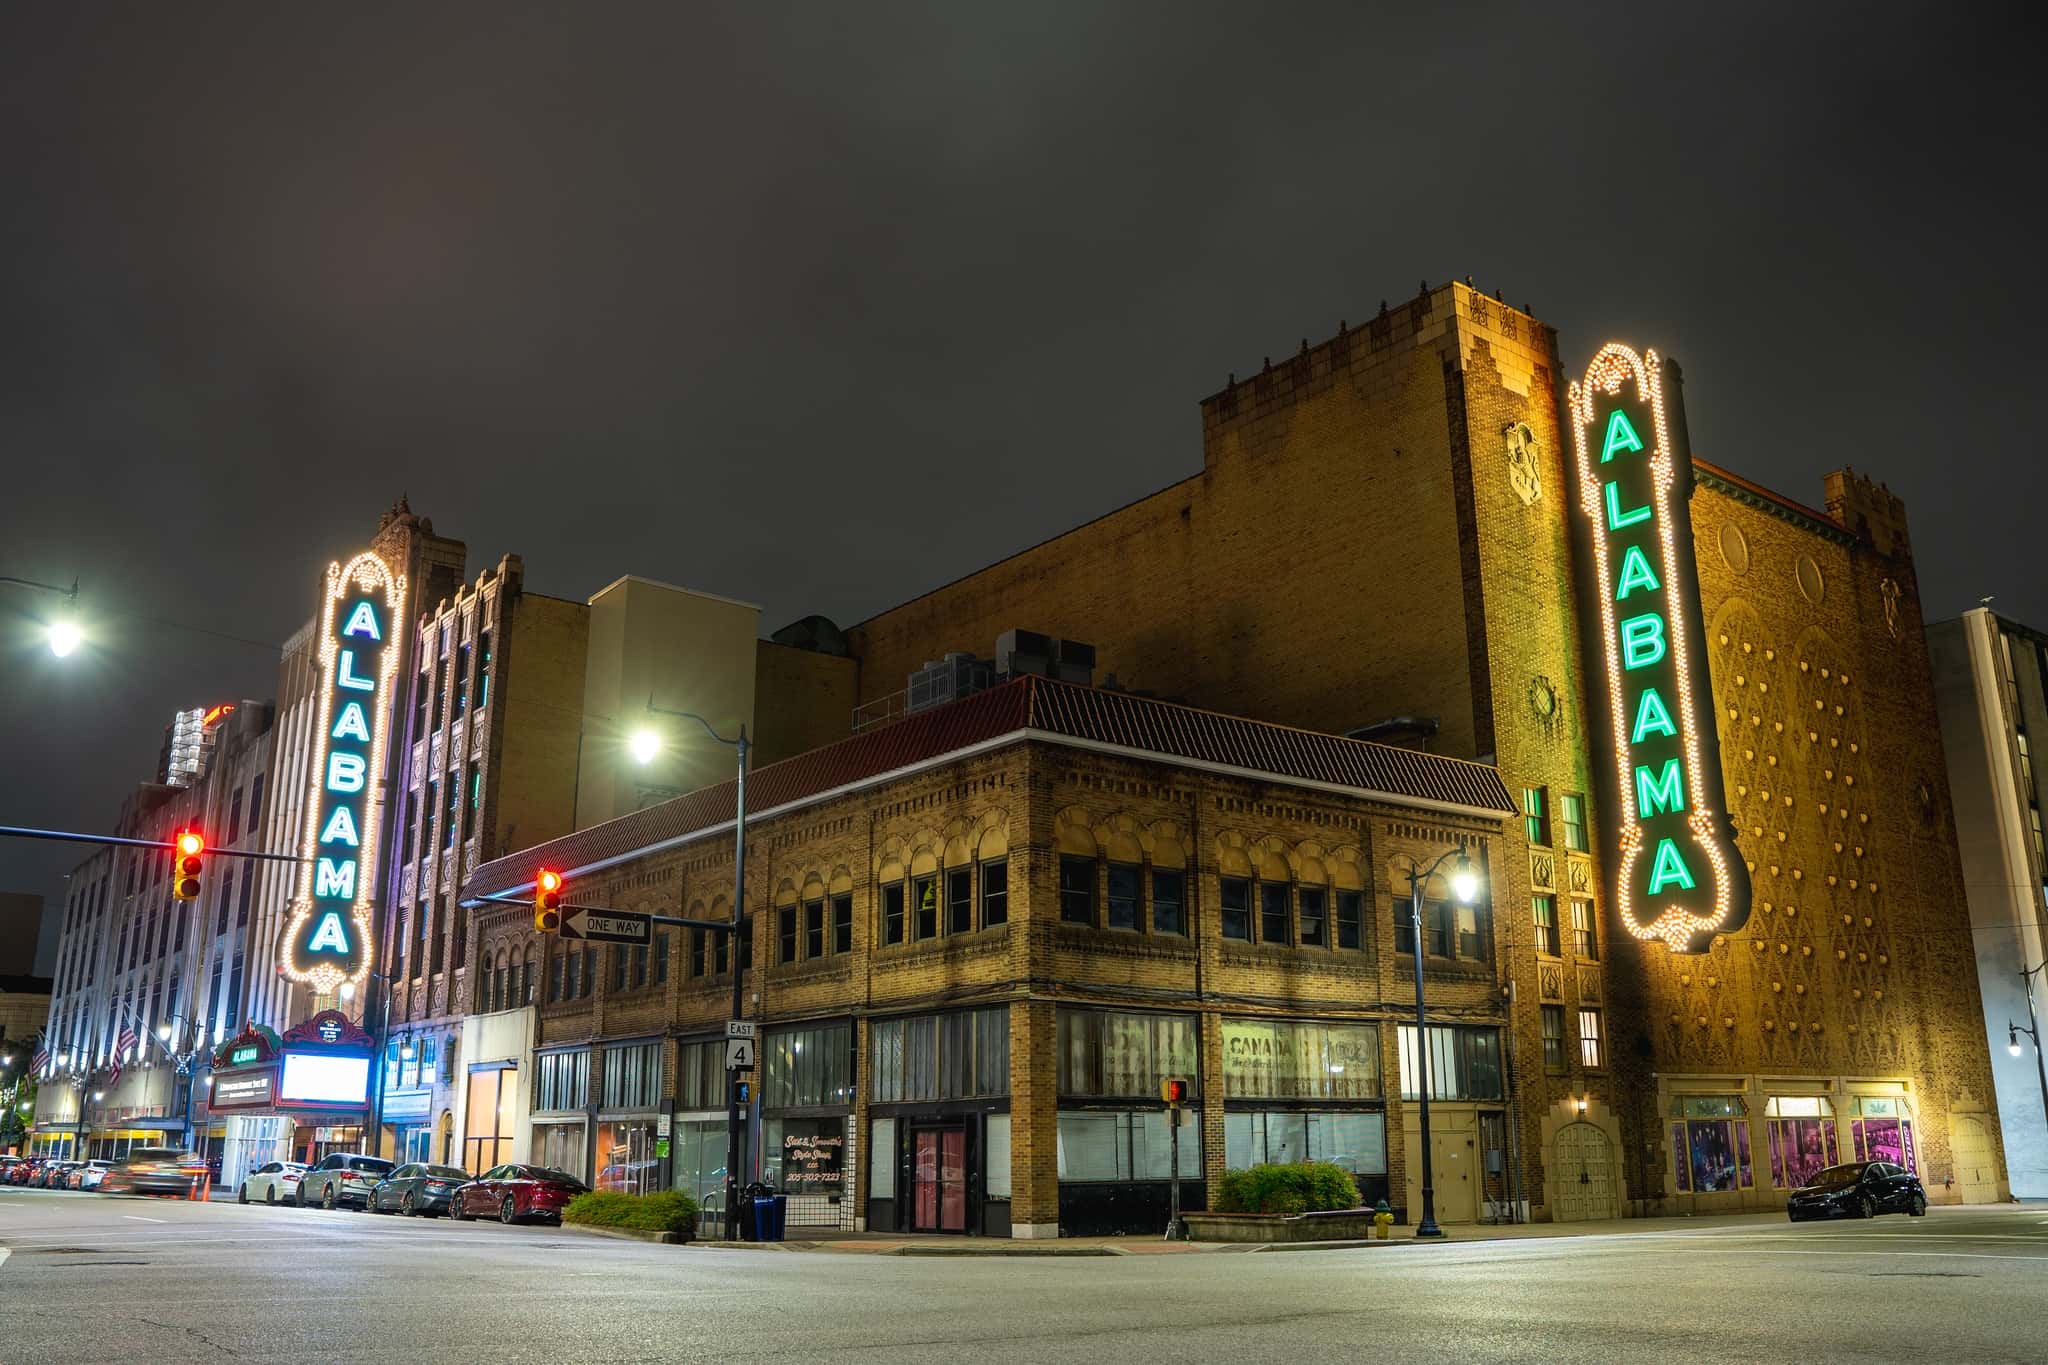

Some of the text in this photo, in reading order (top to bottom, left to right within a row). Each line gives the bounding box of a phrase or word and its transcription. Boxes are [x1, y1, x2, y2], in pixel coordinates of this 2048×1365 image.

[1600, 408, 1696, 895] ALABAMA
[309, 601, 381, 954] ALABAMA
[587, 918, 641, 935] ONE WAY
[730, 1023, 752, 1035] EAST
[233, 1047, 257, 1063] ALABAMA
[734, 1046, 746, 1064] 4
[792, 1149, 811, 1160] Style
